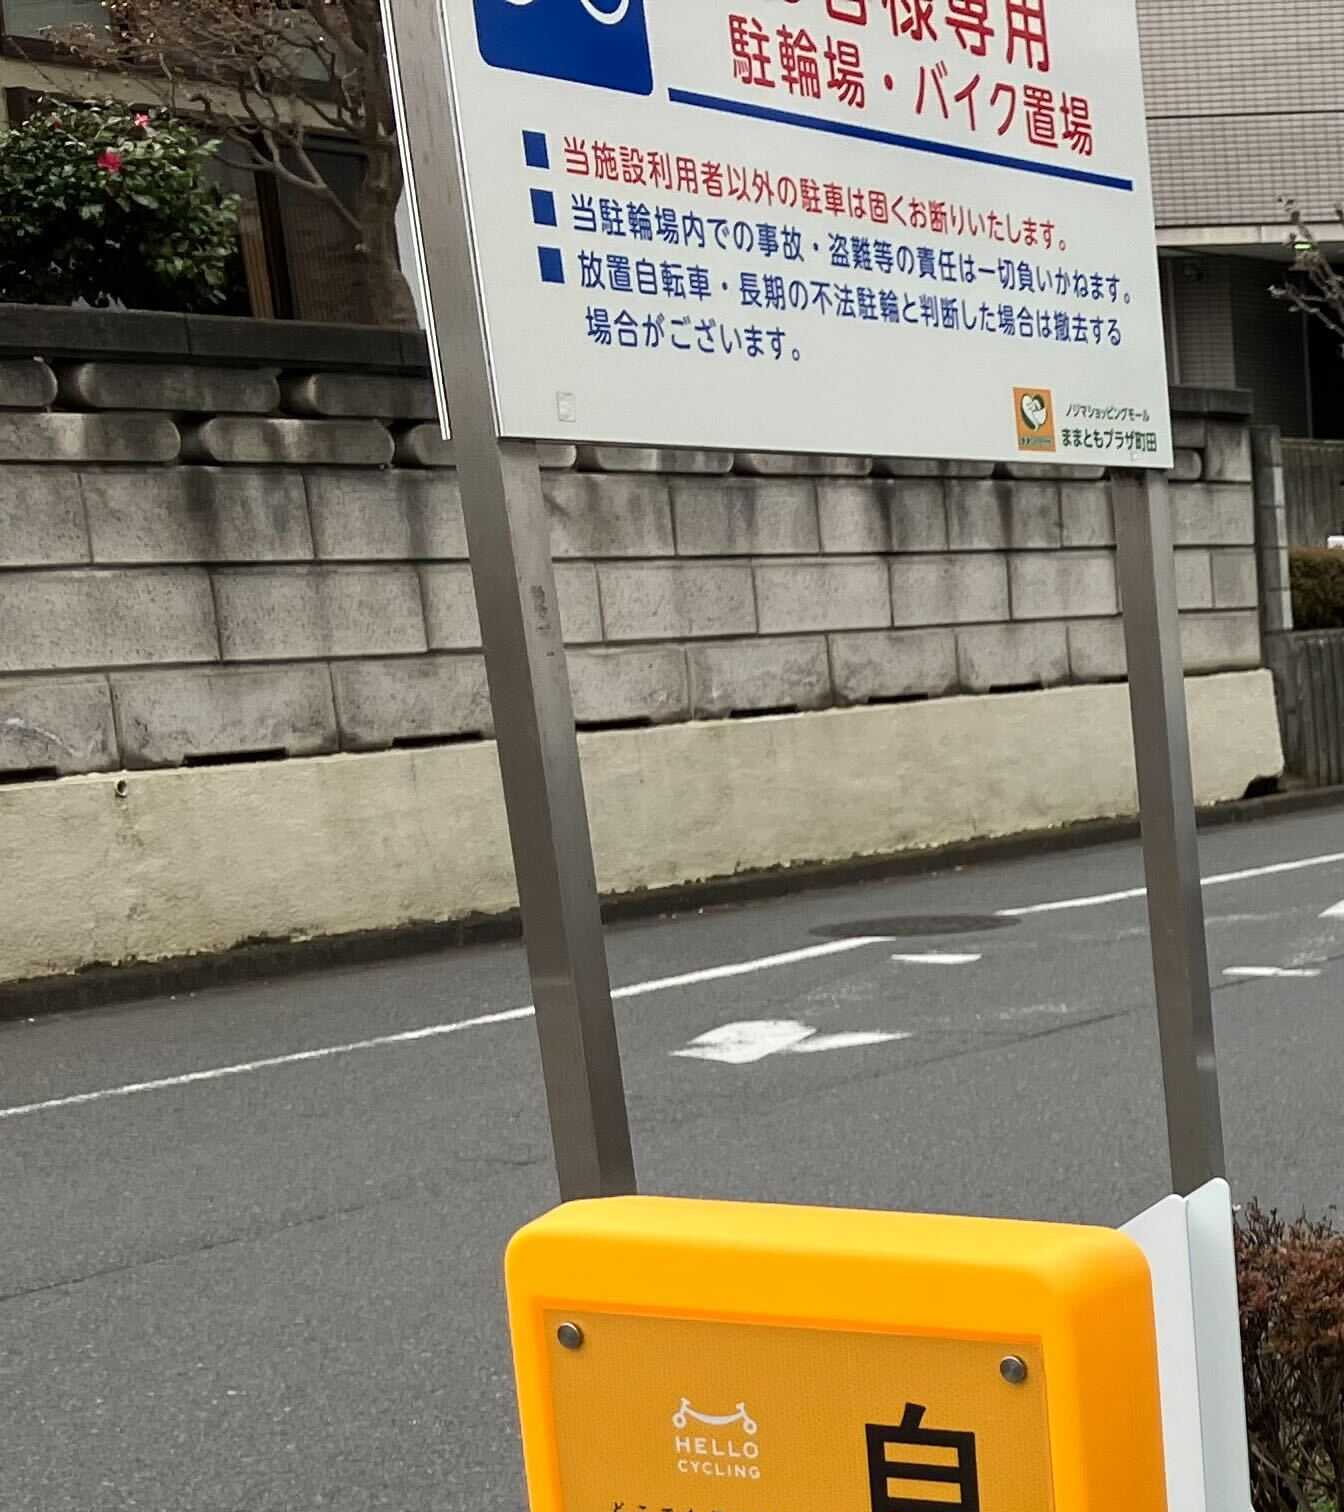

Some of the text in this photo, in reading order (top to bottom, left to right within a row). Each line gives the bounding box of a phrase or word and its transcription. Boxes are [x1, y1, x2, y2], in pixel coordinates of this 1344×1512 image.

[728, 14, 1093, 156] 駐輪場・バイク置場
[564, 136, 1066, 251] 当施設利用者以外の駐車は固くお断りいたします。
[571, 192, 1131, 304] 当駐輪場内での事故・盗難等の責任は一切負いかねます。
[577, 249, 1121, 346] 放置自転車・長期の不法駐輪と判断した場合は撤去する
[585, 305, 800, 361] 場合がございます。
[1061, 428, 1157, 452] ままともプラザ町田
[675, 1435, 759, 1459] HELLO
[677, 1459, 761, 1480] CYCLING
